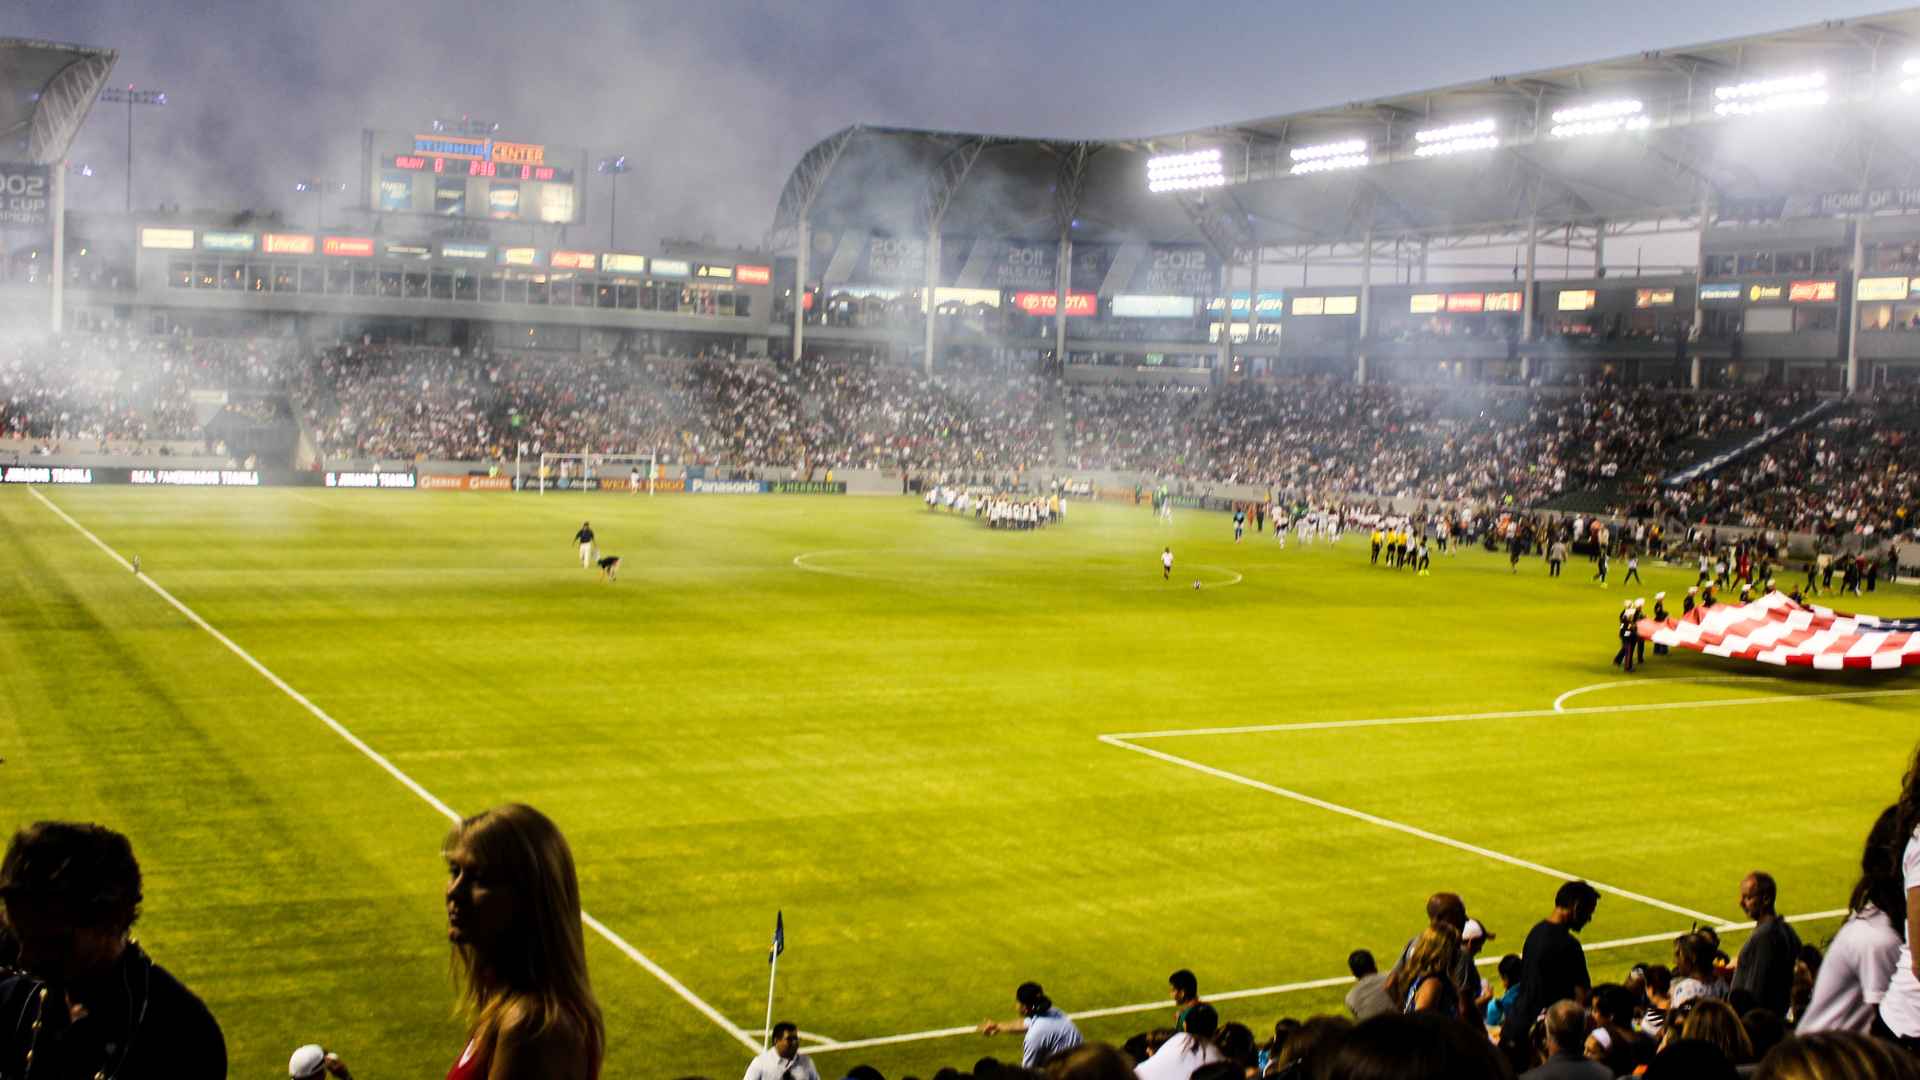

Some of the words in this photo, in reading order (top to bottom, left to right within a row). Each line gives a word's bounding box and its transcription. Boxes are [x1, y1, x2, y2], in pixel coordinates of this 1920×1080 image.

[0, 174, 44, 196] 02
[1823, 192, 1862, 209] HOME
[1153, 250, 1206, 270] 2012
[1041, 296, 1088, 309] TOOTA
[692, 477, 760, 493] Panasonic
[786, 481, 840, 493] HERBALIFE
